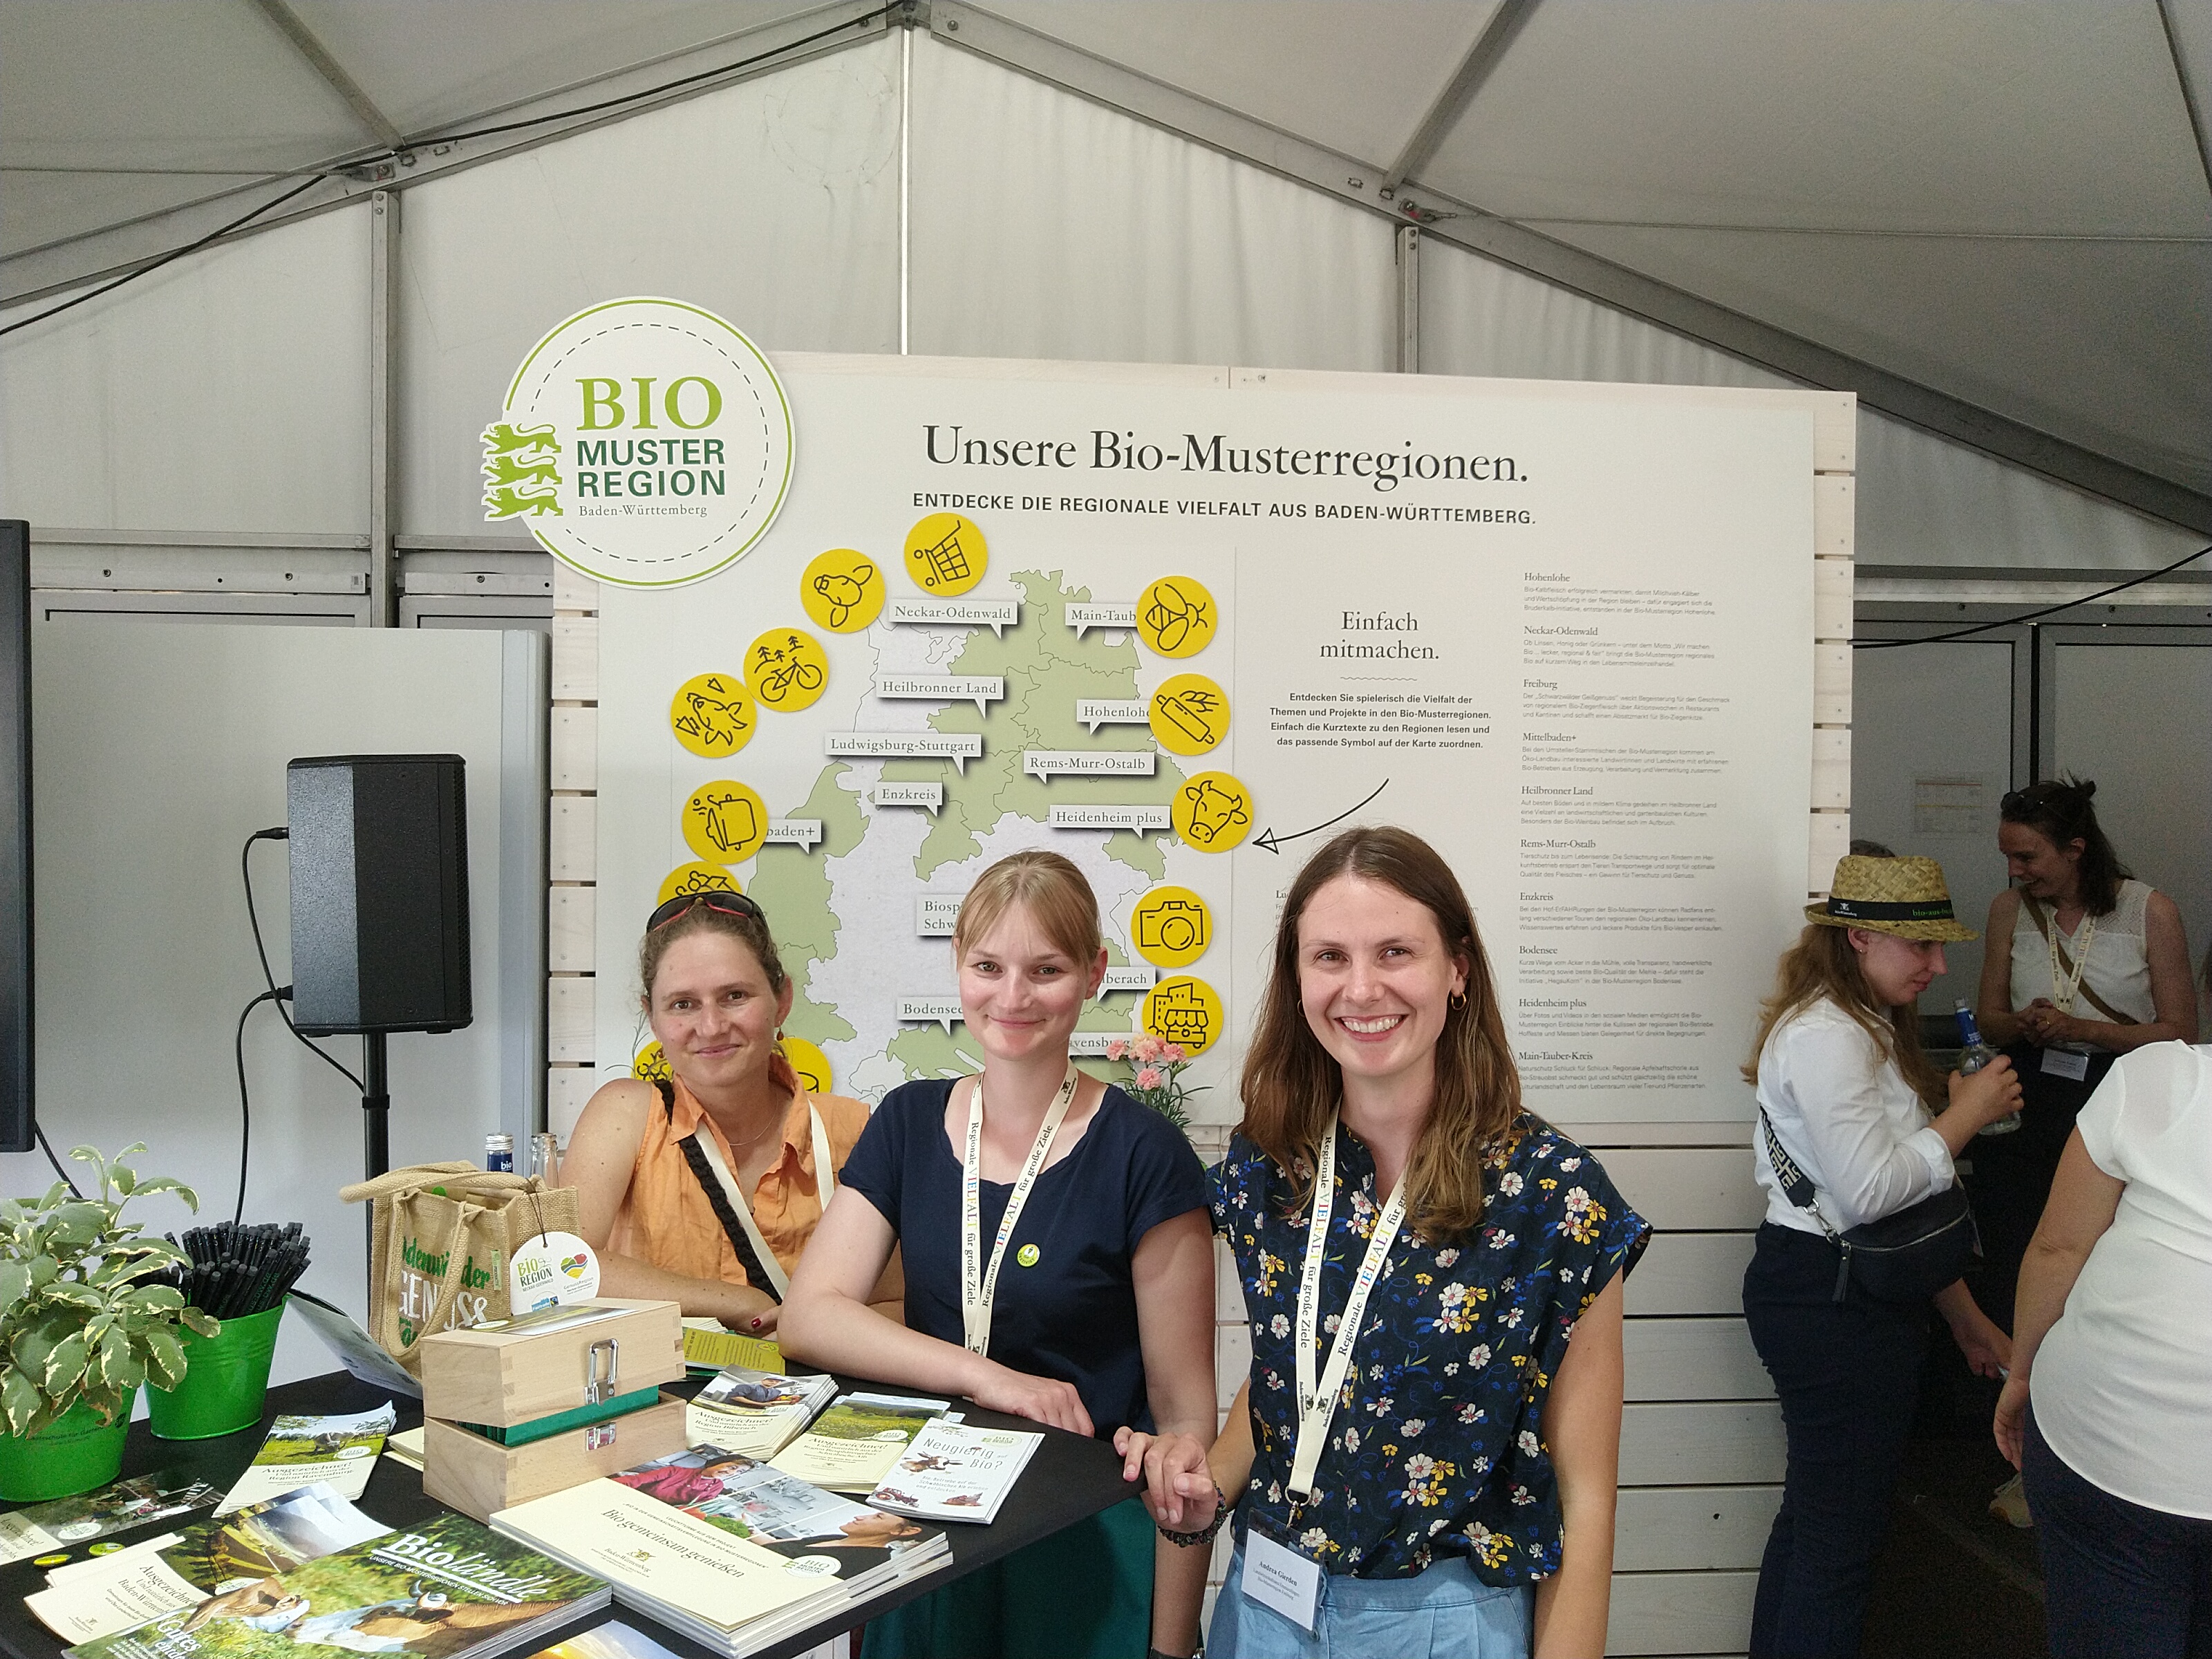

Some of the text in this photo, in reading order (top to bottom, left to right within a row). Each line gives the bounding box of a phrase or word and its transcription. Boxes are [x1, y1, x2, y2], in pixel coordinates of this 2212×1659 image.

[575, 376, 722, 431] BIO
[578, 439, 724, 466] MUSTER
[923, 425, 1527, 491] Unsere Bio-Musterregionen.
[579, 470, 725, 497] REGION
[579, 505, 708, 518] Baden-Württemberg
[914, 493, 1535, 524] ENTDECKE DIE REGIONALE VIELFALT AUS BADEN-WÜRTTEMBERG.
[1525, 572, 1570, 581] Hohenlohe
[895, 606, 1010, 619] Neckar-Odenwald
[1342, 612, 1417, 630] Einfach
[1524, 626, 1598, 635] Neckar-Odenwald
[1320, 639, 1438, 659] mitmachen.
[883, 682, 996, 693] Heilbronner Land
[1524, 679, 1557, 691] Freiburg
[1290, 693, 1337, 701] Entdecken
[1357, 694, 1404, 704] spielerisch
[1329, 709, 1367, 718] Projekte
[1400, 709, 1491, 720] Bio-Musterregionen.
[1271, 722, 1304, 731] Einfach
[1323, 723, 1367, 731] Kurztexte
[1402, 724, 1443, 734] Regionen
[1295, 738, 1338, 747] passende
[1341, 738, 1375, 748] Symbol
[1523, 733, 1576, 741] Mittelbaden+
[832, 738, 974, 754] Ludwigsburg-Stuttgart
[1031, 758, 1145, 769] Rems-Murr-Ostalb
[883, 789, 935, 799] Enzkreis
[1521, 786, 1593, 795] Heilbronner Land
[1056, 812, 1161, 825] Heidenheim plus
[1521, 839, 1596, 847] Rems-Murr-Ostalb
[1520, 892, 1553, 901] Enzkreis
[1519, 946, 1557, 954] Bodensee
[1519, 998, 1586, 1010] Heidenheim plus
[1519, 1051, 1593, 1060] Main-Tauber-Kreis
[501, 1161, 512, 1170] bio
[965, 1122, 979, 1306] Regionale VIELFALT für große Ziele
[982, 1125, 1053, 1307] Regionale VIELFALT für große Ziele
[1300, 1136, 1331, 1348] Regionale VIELFALT für große Ziele
[521, 1267, 553, 1287] REGION
[1338, 1302, 1362, 1356] Regionale
[1355, 1225, 1392, 1297] VIELFALT
[1387, 1209, 1400, 1226] für
[695, 1412, 773, 1423] Ausgezeichnet!
[809, 1438, 888, 1450] Ausgezeichnet!
[924, 1438, 994, 1459] Neugierig
[263, 1462, 351, 1473] Ausgezeichnet!
[970, 1459, 1002, 1470] Bio?
[601, 1509, 624, 1522] Bio
[617, 1521, 689, 1556] gemeinsam
[680, 1550, 745, 1578] genießen
[381, 1534, 554, 1598] Bioländle
[805, 1559, 830, 1568] BIO
[369, 1556, 395, 1567] UNSERE
[394, 1562, 460, 1589] BIO-MUSTERREGIONEN
[458, 1584, 482, 1597] STELLEN
[1259, 1562, 1277, 1575] Andrea
[1278, 1571, 1297, 1586] Gierden
[158, 1620, 202, 1651] Gutes
